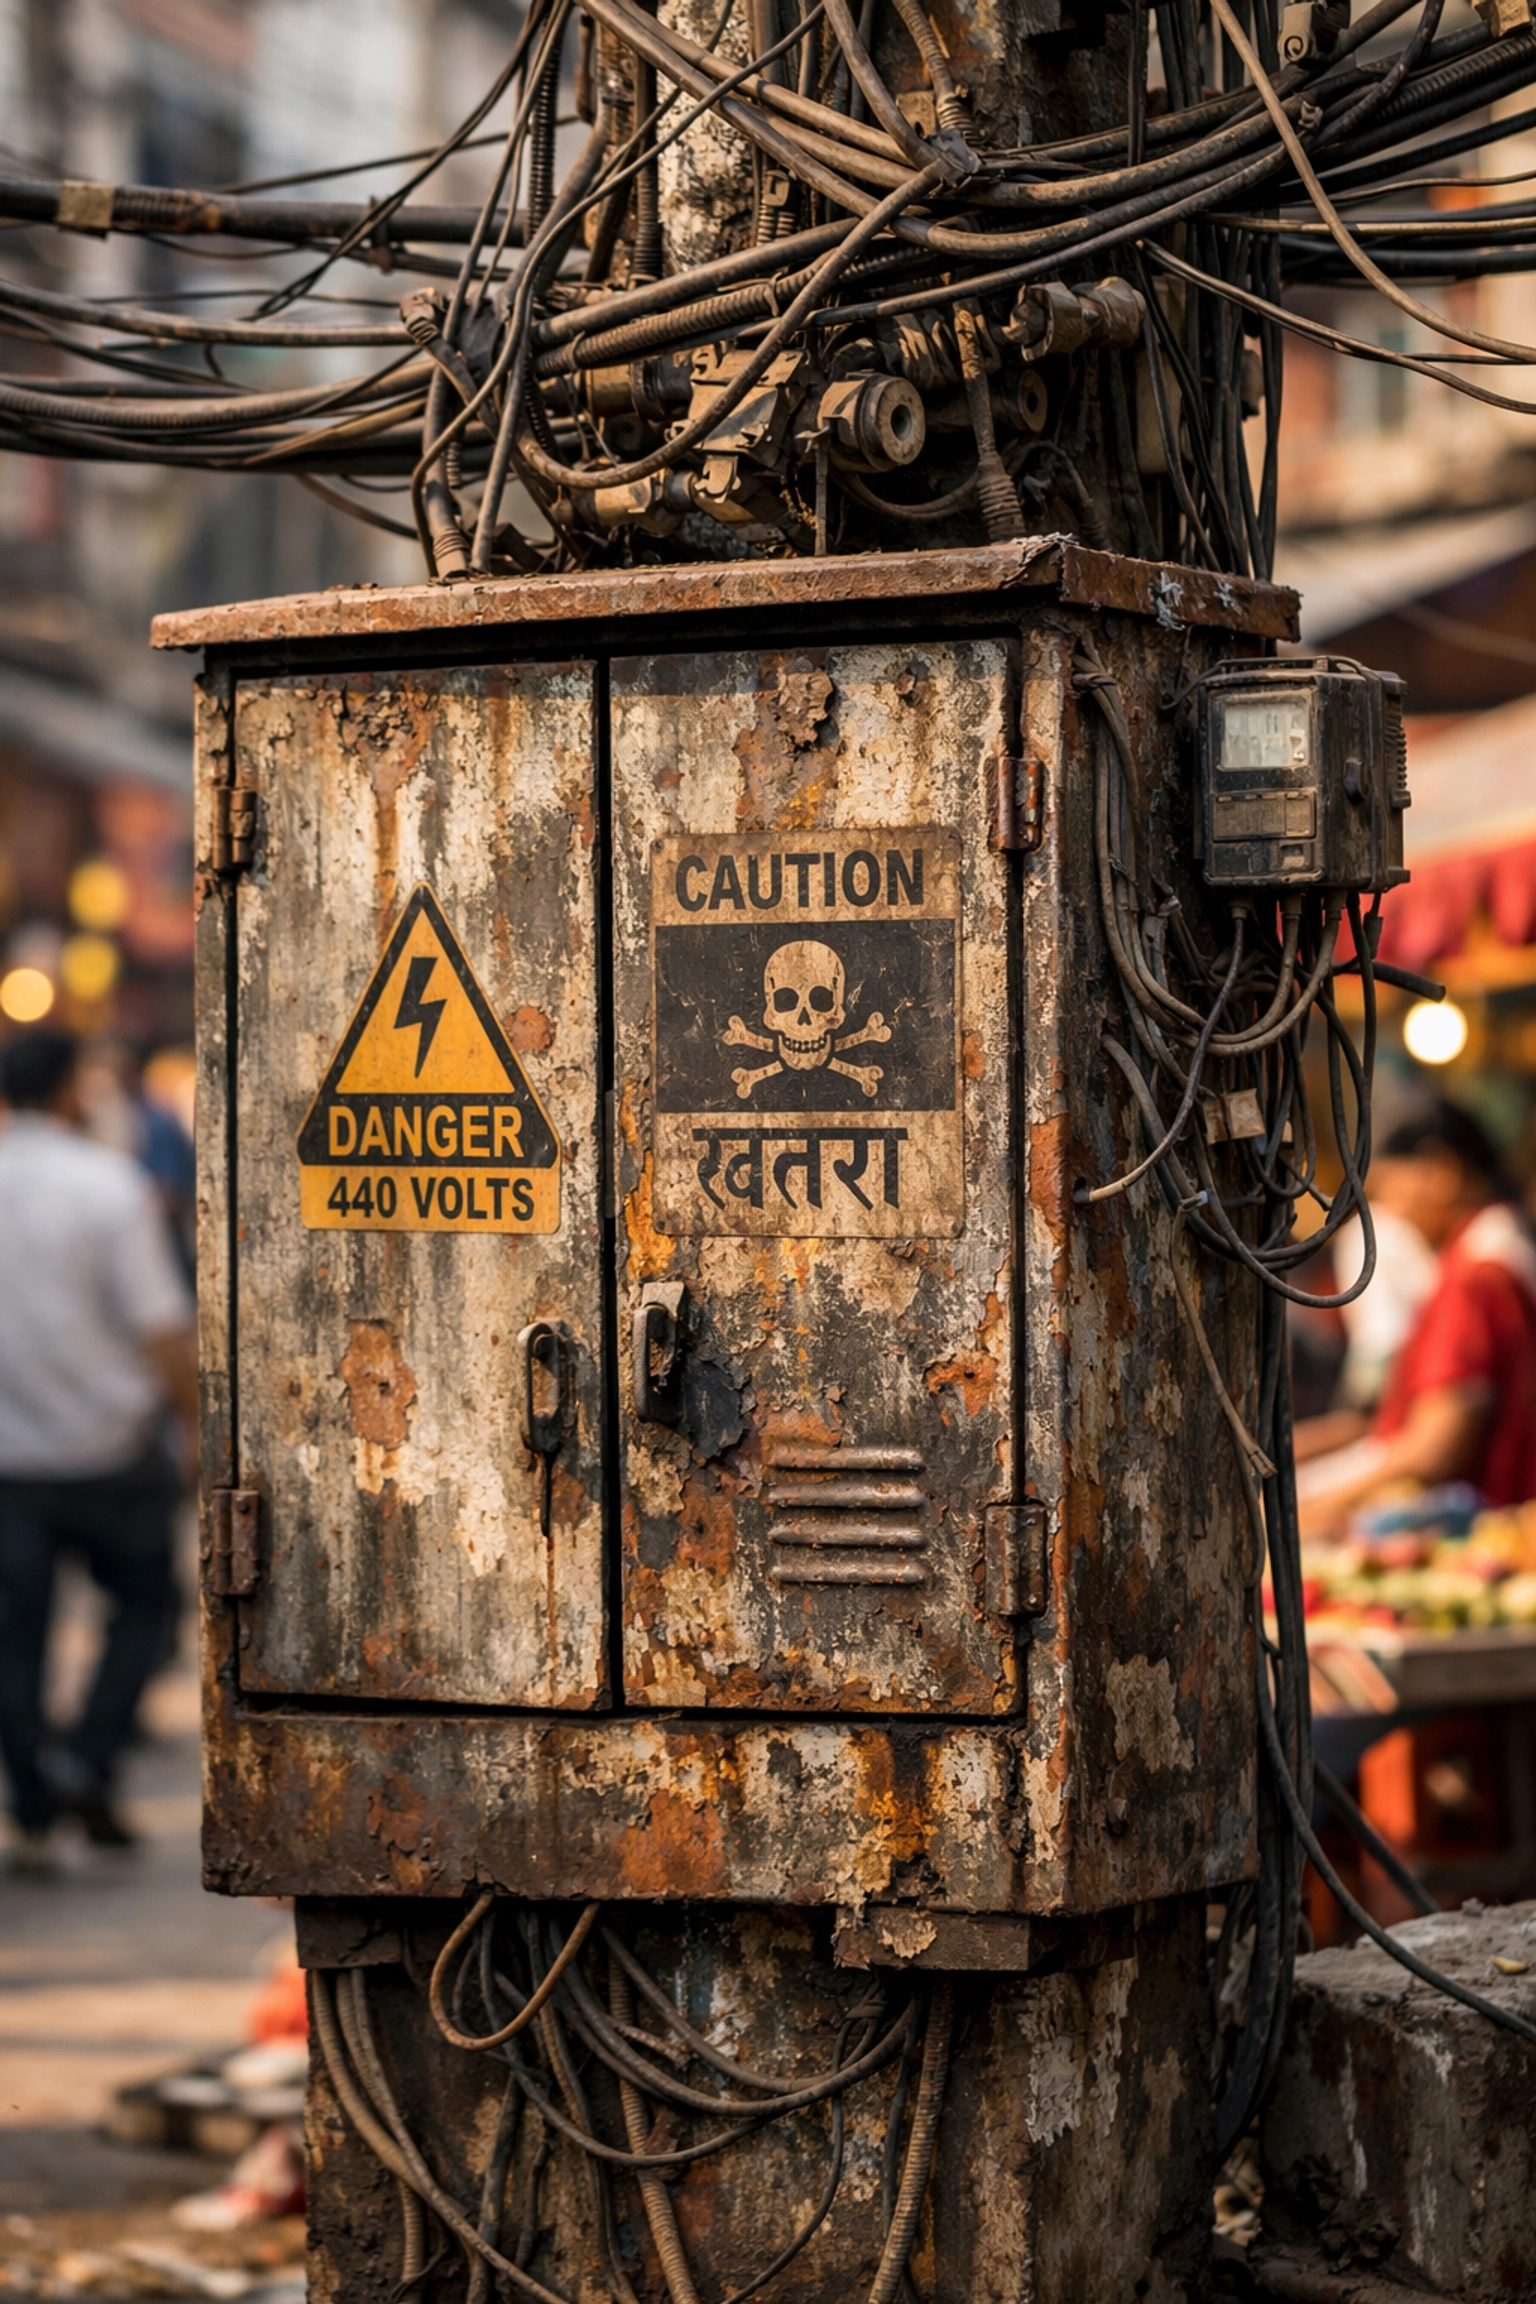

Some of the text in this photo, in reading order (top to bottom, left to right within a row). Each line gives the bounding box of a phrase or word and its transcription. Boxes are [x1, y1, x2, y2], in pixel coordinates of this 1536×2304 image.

[674, 848, 925, 912] CAUTION
[328, 1105, 525, 1158] DANGER
[327, 1175, 536, 1222] 440 VOLTS
